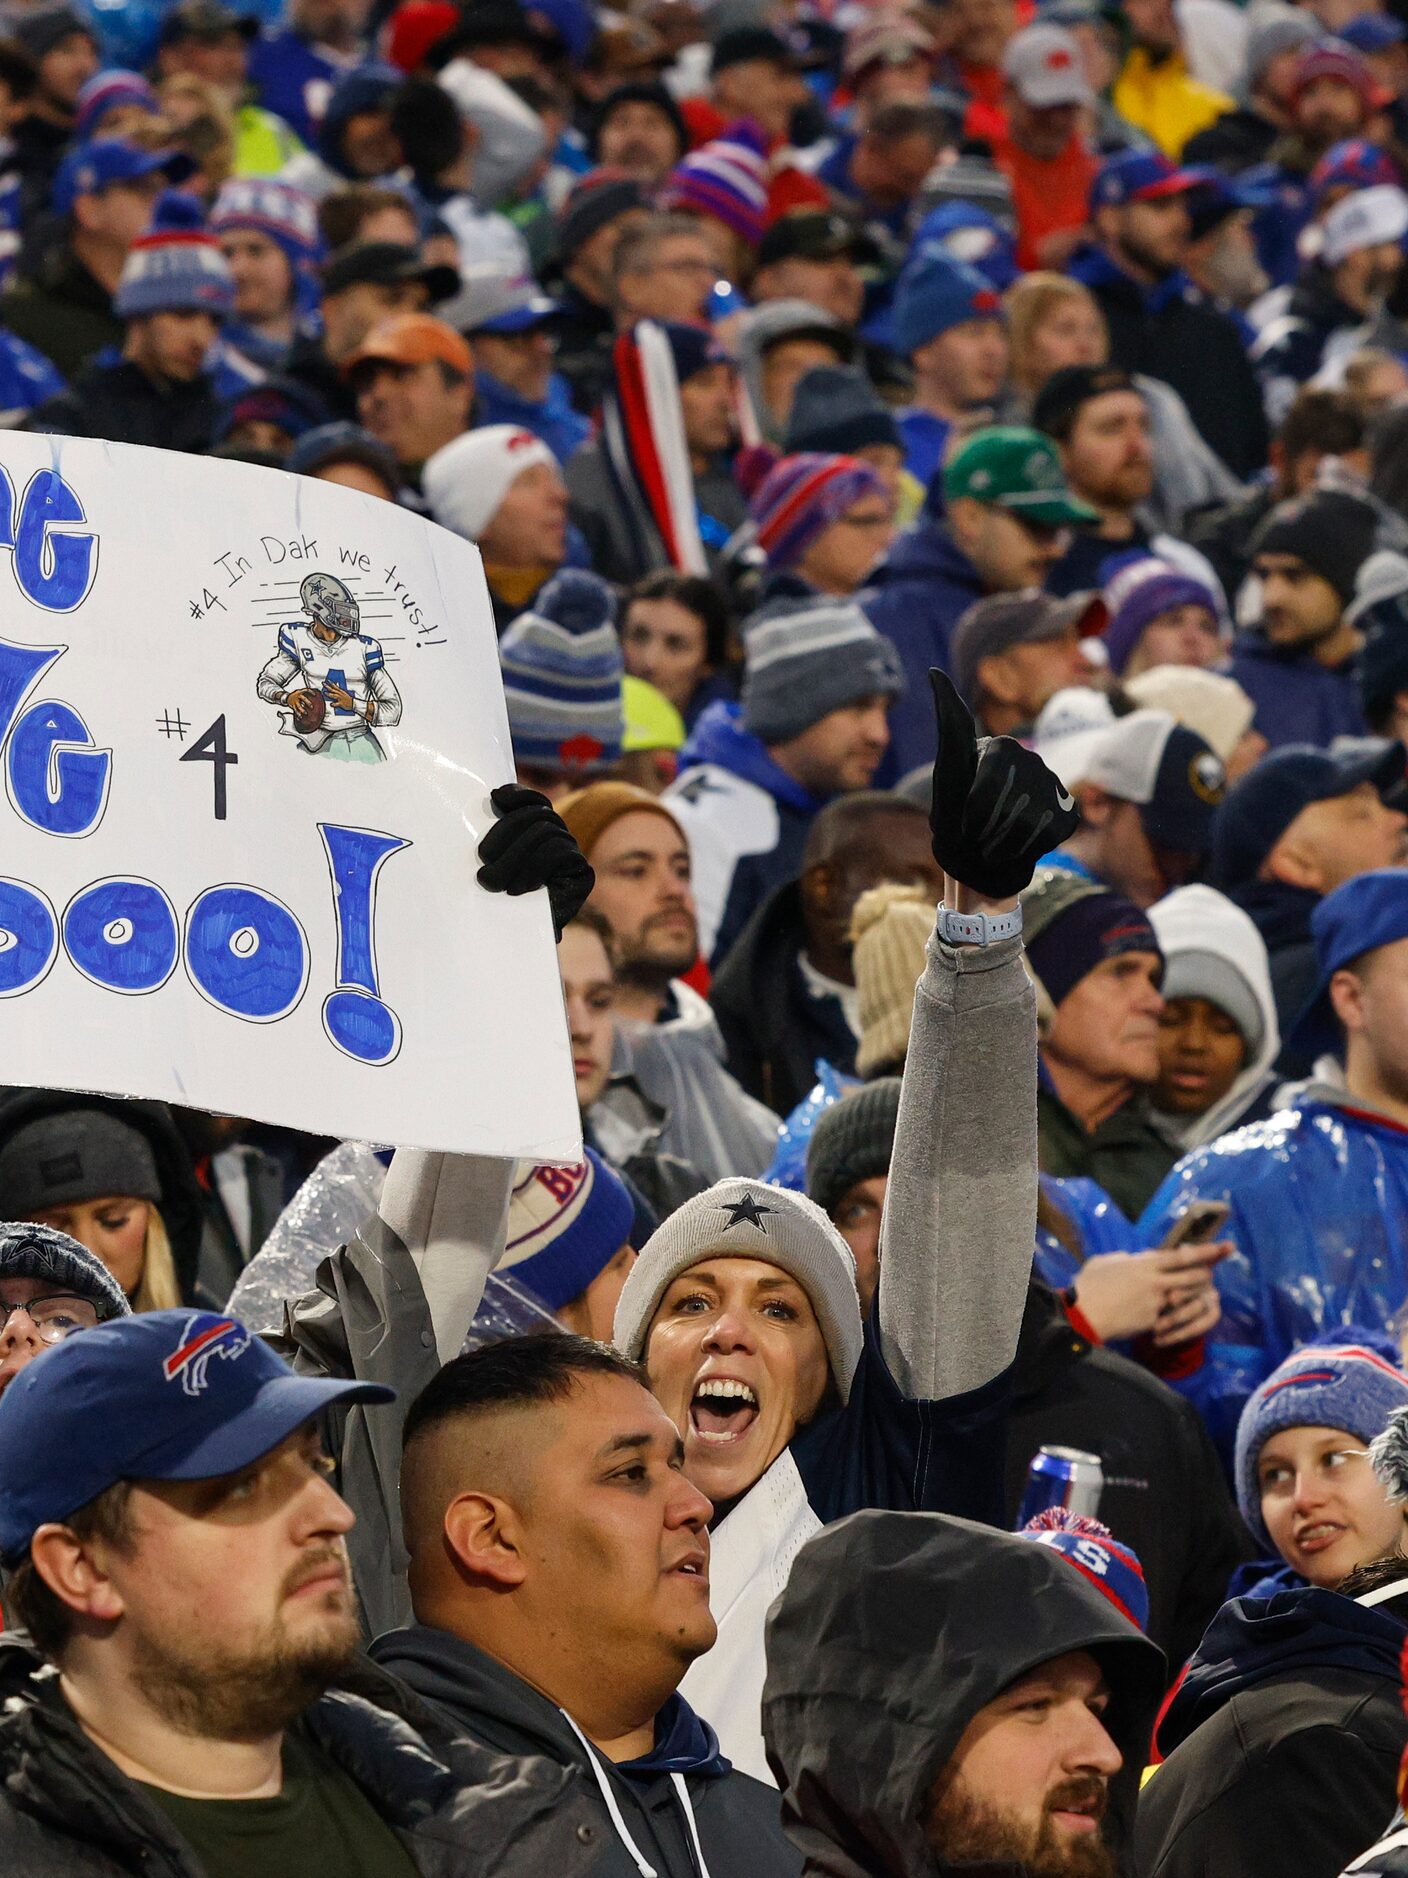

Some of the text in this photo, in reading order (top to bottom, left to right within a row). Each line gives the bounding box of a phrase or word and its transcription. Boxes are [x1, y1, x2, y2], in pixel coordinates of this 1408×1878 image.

[189, 534, 448, 649] #4 In Dak we trust!
